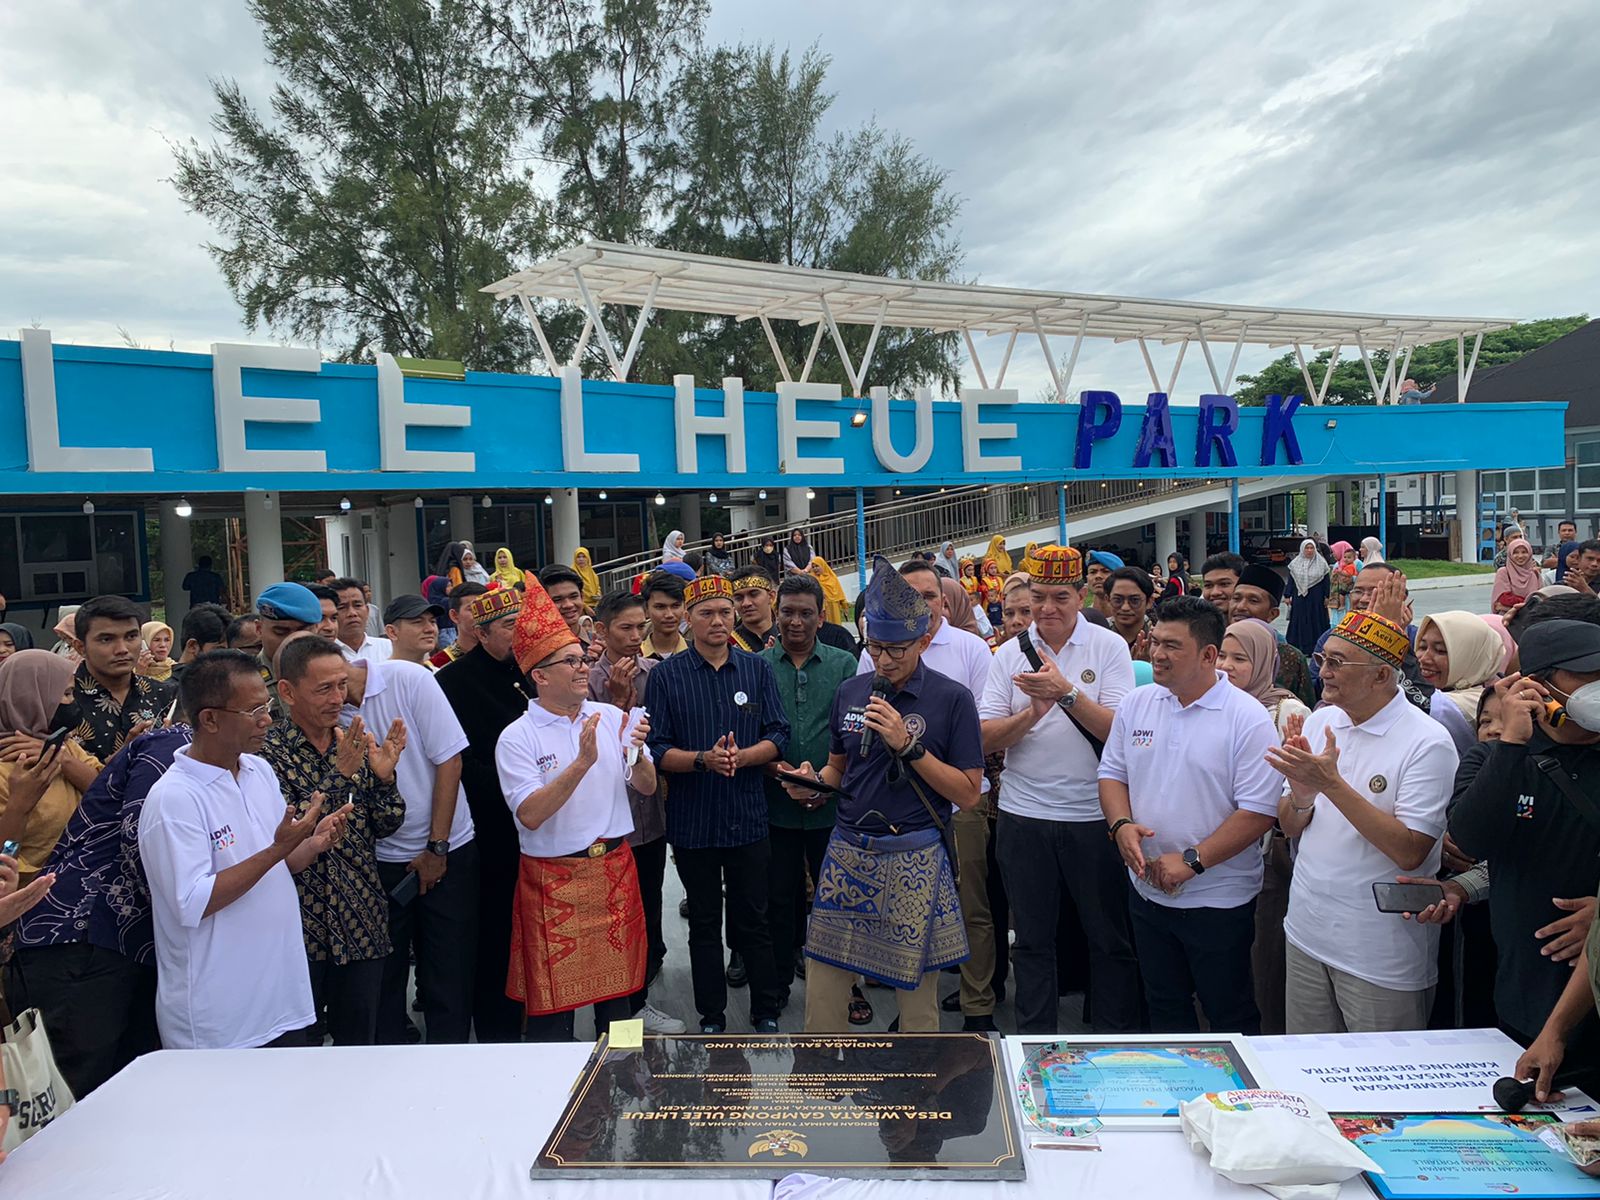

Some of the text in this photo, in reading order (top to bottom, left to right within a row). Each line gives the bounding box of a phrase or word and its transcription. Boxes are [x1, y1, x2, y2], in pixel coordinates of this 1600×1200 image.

[20, 328, 1304, 474] LEE LHEUE PARK
[1132, 730, 1154, 738] ADWI
[1131, 737, 1153, 748] 2022
[536, 753, 556, 766] ADWI
[538, 760, 559, 774] 022
[209, 824, 232, 841] ADWI
[1301, 1061, 1500, 1075] KAMPUNG BERSERI ASTRA
[1320, 1070, 1501, 1084] DESA WISATA MENJADI
[1352, 1080, 1488, 1092] PENGEMBANGAN
[1229, 1093, 1306, 1105] DESA WISATA
[620, 1111, 952, 1120] DESA WISATA GAMPONG ULEE LHEUE
